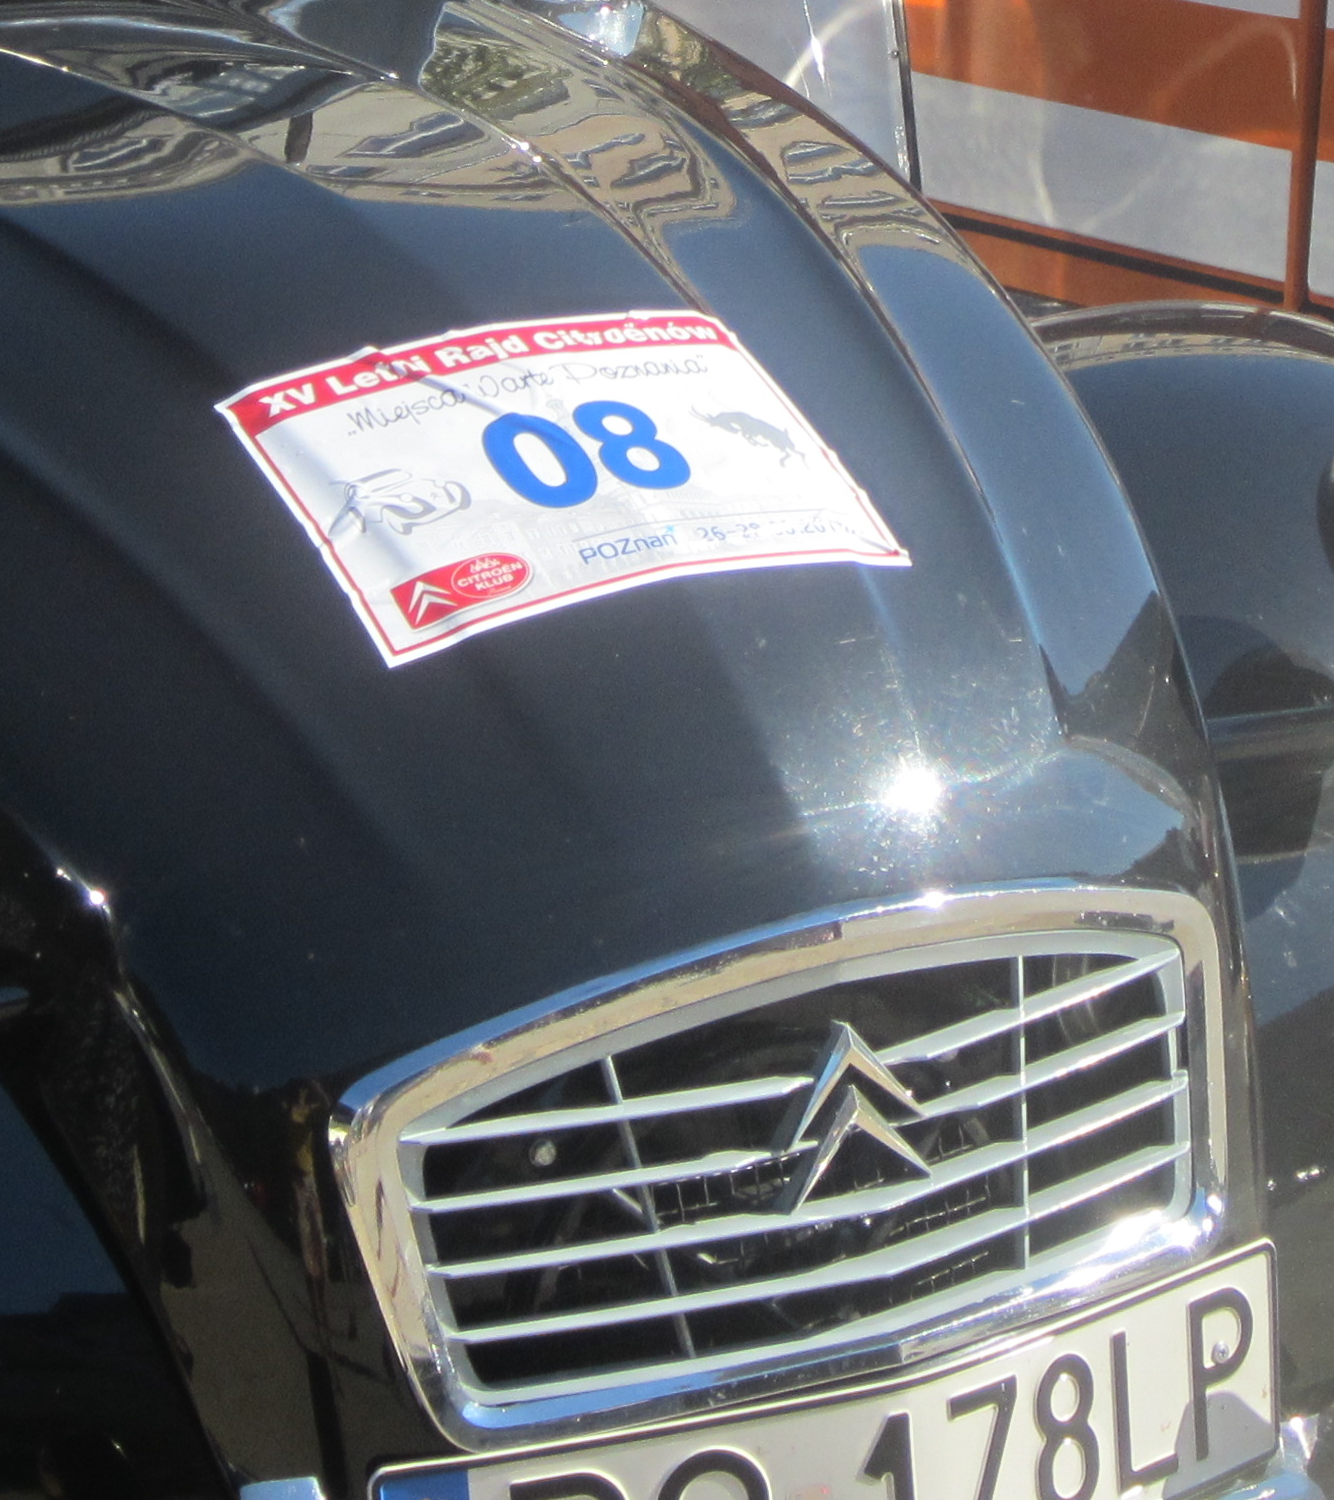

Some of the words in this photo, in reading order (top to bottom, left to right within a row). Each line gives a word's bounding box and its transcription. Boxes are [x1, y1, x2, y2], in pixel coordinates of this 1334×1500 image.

[258, 383, 318, 419] XV
[329, 355, 426, 397] Letni
[434, 332, 530, 369] Rajd
[482, 400, 691, 509] 08
[475, 573, 515, 592] KLUB
[857, 1286, 1254, 1500] 178LP
